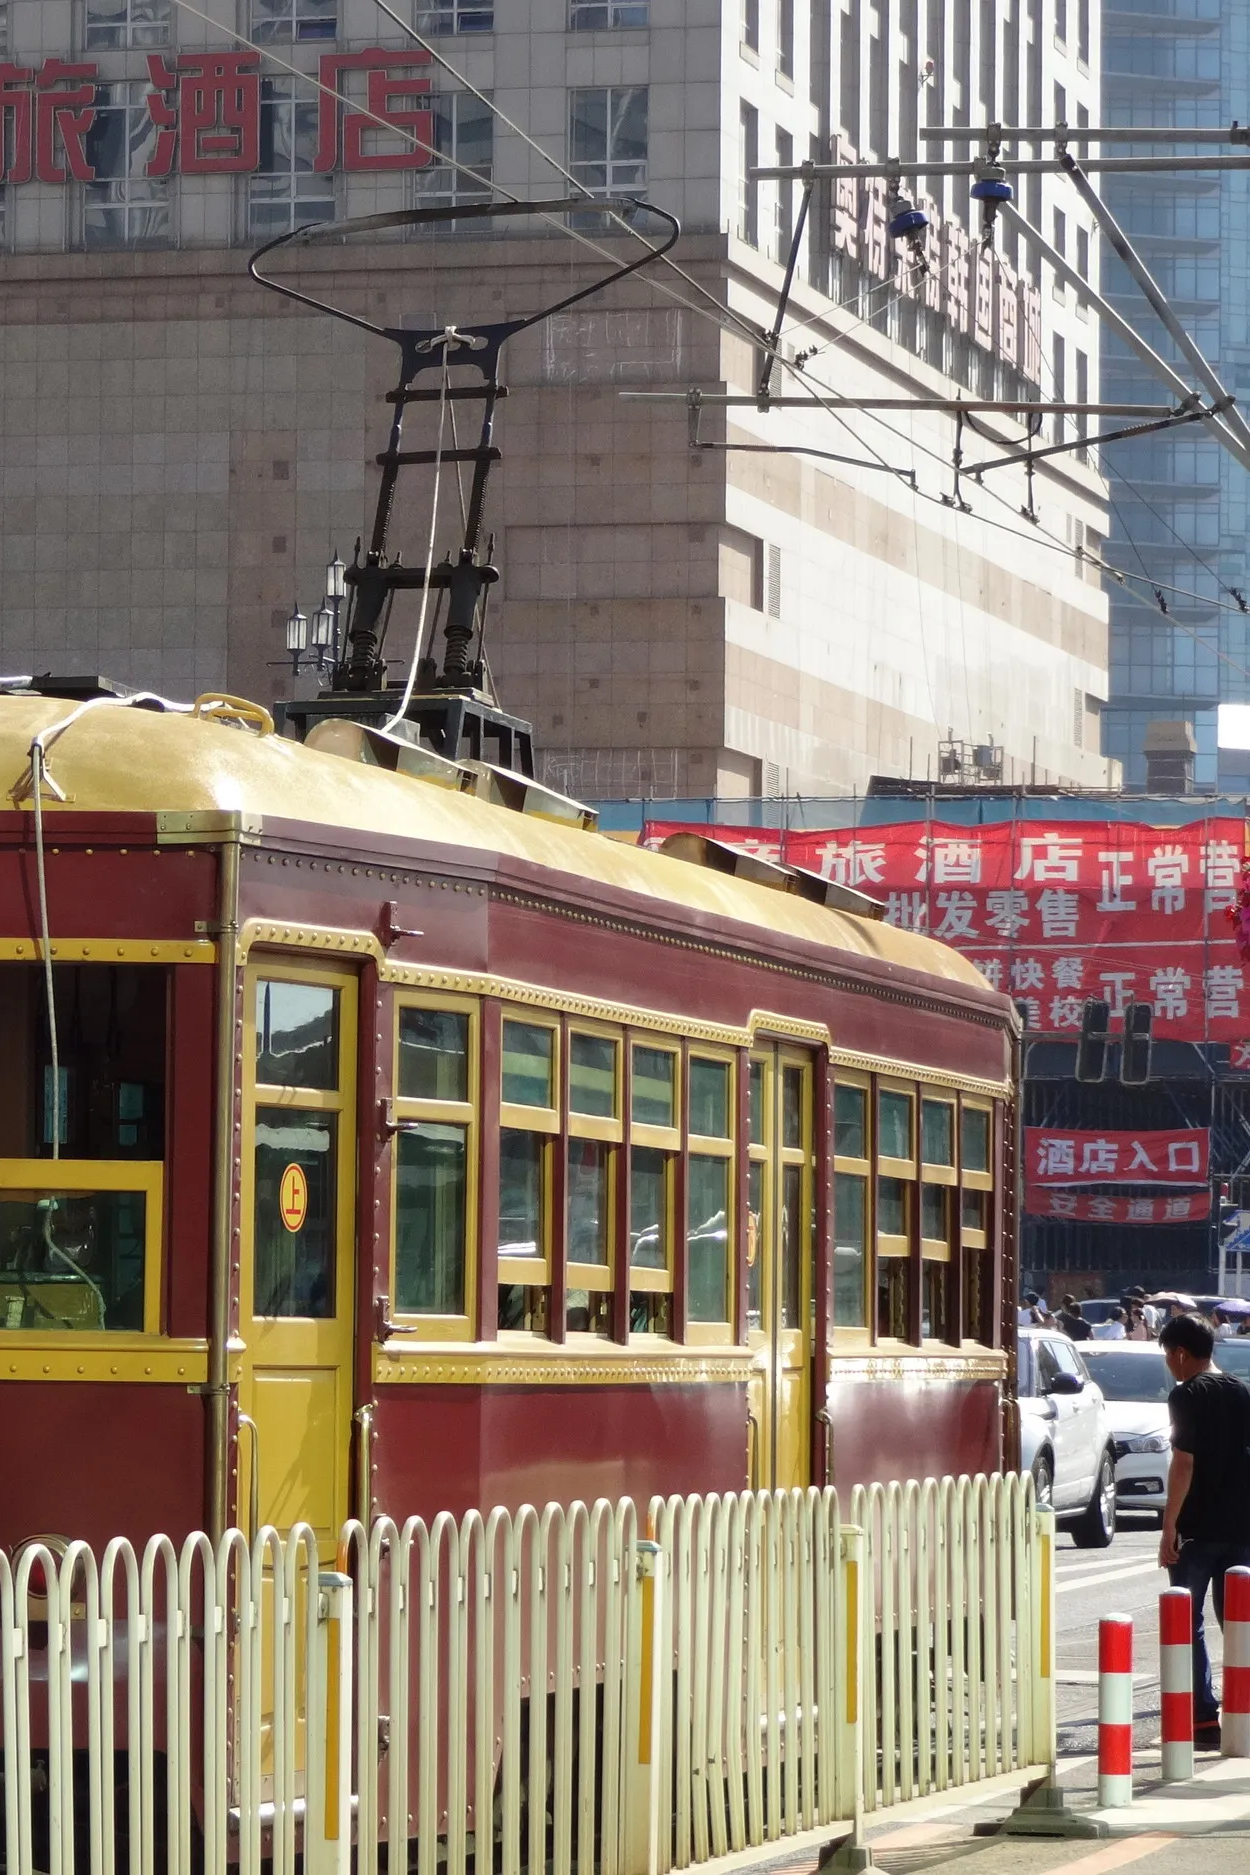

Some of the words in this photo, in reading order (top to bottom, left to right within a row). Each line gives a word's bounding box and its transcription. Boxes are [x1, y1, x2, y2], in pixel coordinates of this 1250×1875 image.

[1036, 1137, 1200, 1175] 酒店入口
[286, 1175, 301, 1215] 上
[1050, 1193, 1192, 1221] 安全通道
